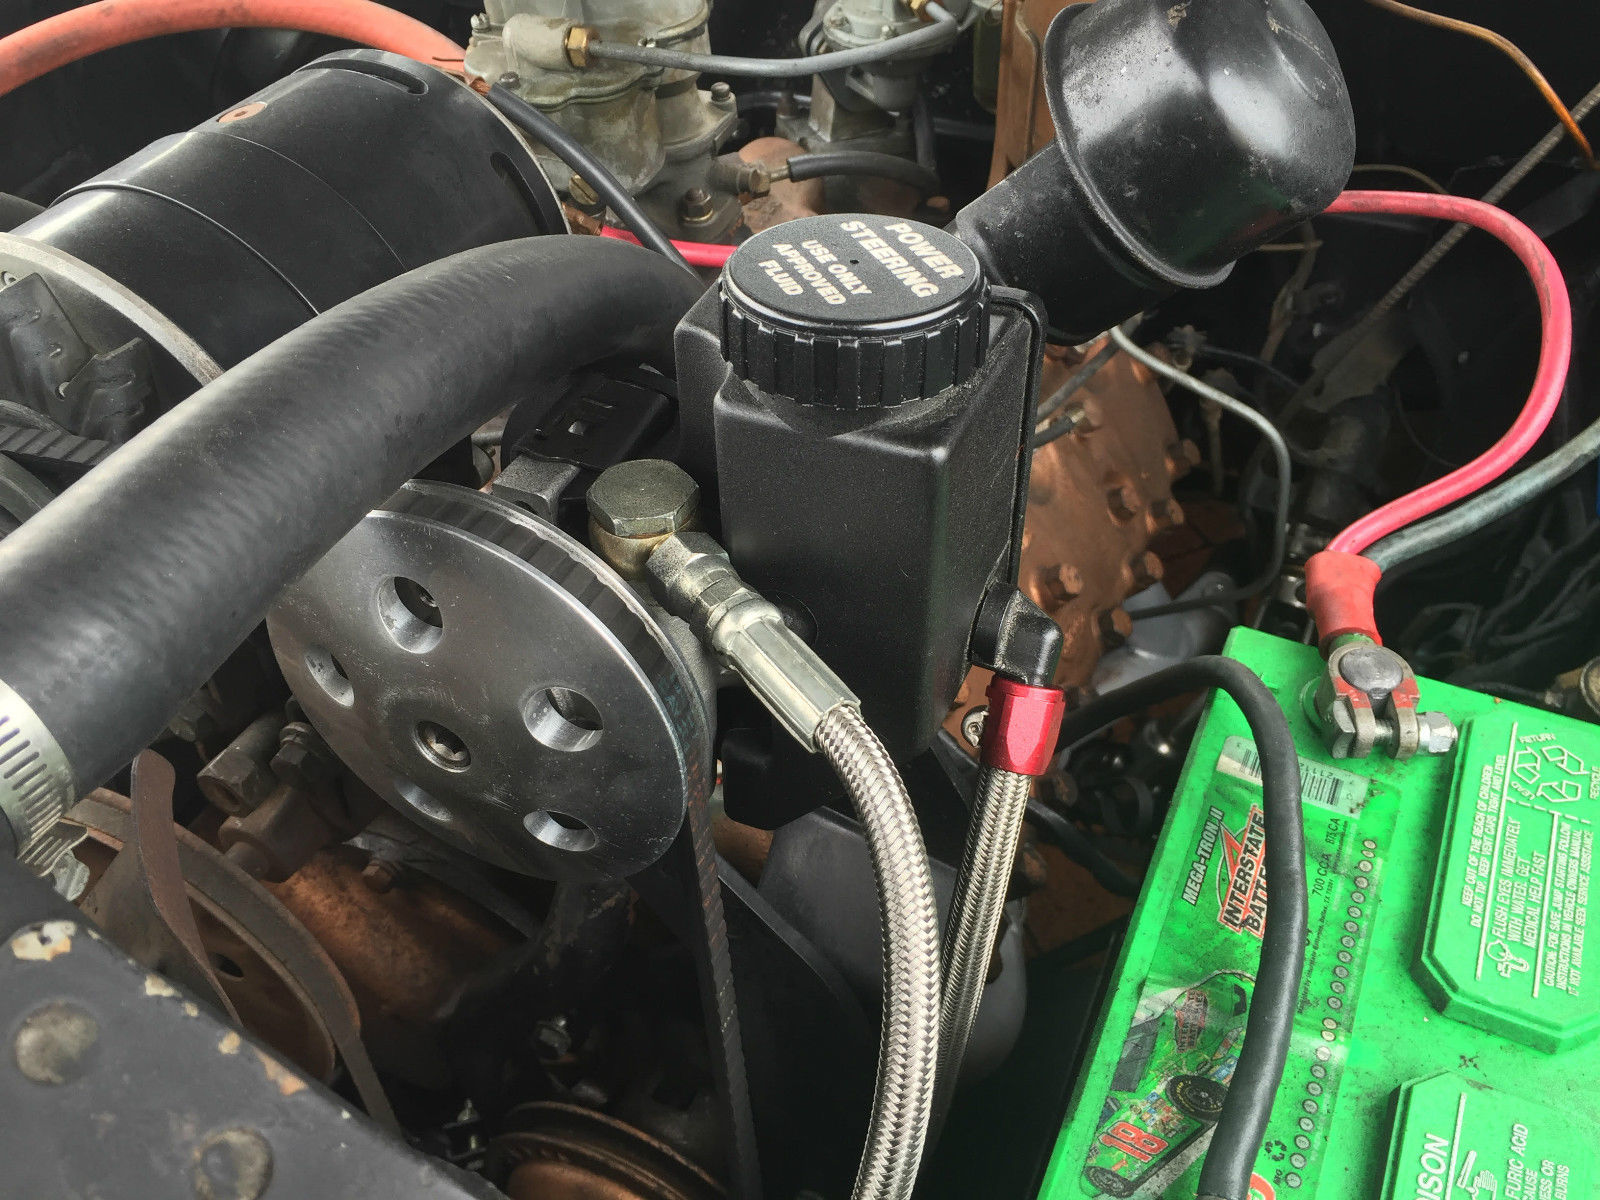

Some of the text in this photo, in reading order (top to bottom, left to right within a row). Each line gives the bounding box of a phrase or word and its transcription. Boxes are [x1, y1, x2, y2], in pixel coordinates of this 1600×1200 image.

[802, 239, 872, 295] USE ONLY
[840, 220, 939, 298] STEERING
[884, 222, 964, 279] POWER
[758, 259, 804, 295] FLUID
[772, 242, 846, 305] APPROVED
[1327, 816, 1341, 832] CA
[1558, 821, 1571, 851] FOLLOW
[1182, 805, 1225, 906] MEGA-TRON II
[1470, 837, 1482, 853] THE
[1481, 835, 1493, 856] VENT
[1223, 812, 1265, 928] INTERSTATE
[1317, 853, 1332, 878] CCA
[1465, 867, 1477, 885] OUT
[1478, 856, 1490, 878] KEEP
[1492, 816, 1520, 939] FLUSH EYES IMMEDIATELY
[1554, 853, 1567, 888] STARTING
[1247, 865, 1268, 932] BATTE
[1312, 878, 1325, 897] 700
[1461, 885, 1474, 907] KEEP
[1507, 916, 1523, 942] WITH
[1515, 856, 1531, 878] GET
[1522, 850, 1545, 948] MEDICAL HELP FAST
[1470, 914, 1482, 928] DO
[1472, 895, 1484, 914] NOT
[1549, 910, 1561, 931] SAFE
[1562, 890, 1576, 922] VEHICLE
[1547, 931, 1559, 950] FOR
[1098, 1120, 1168, 1163] 18
[1510, 1123, 1528, 1157] ACID
[1415, 1133, 1449, 1200] ISON
[1541, 1159, 1555, 1176] OR
